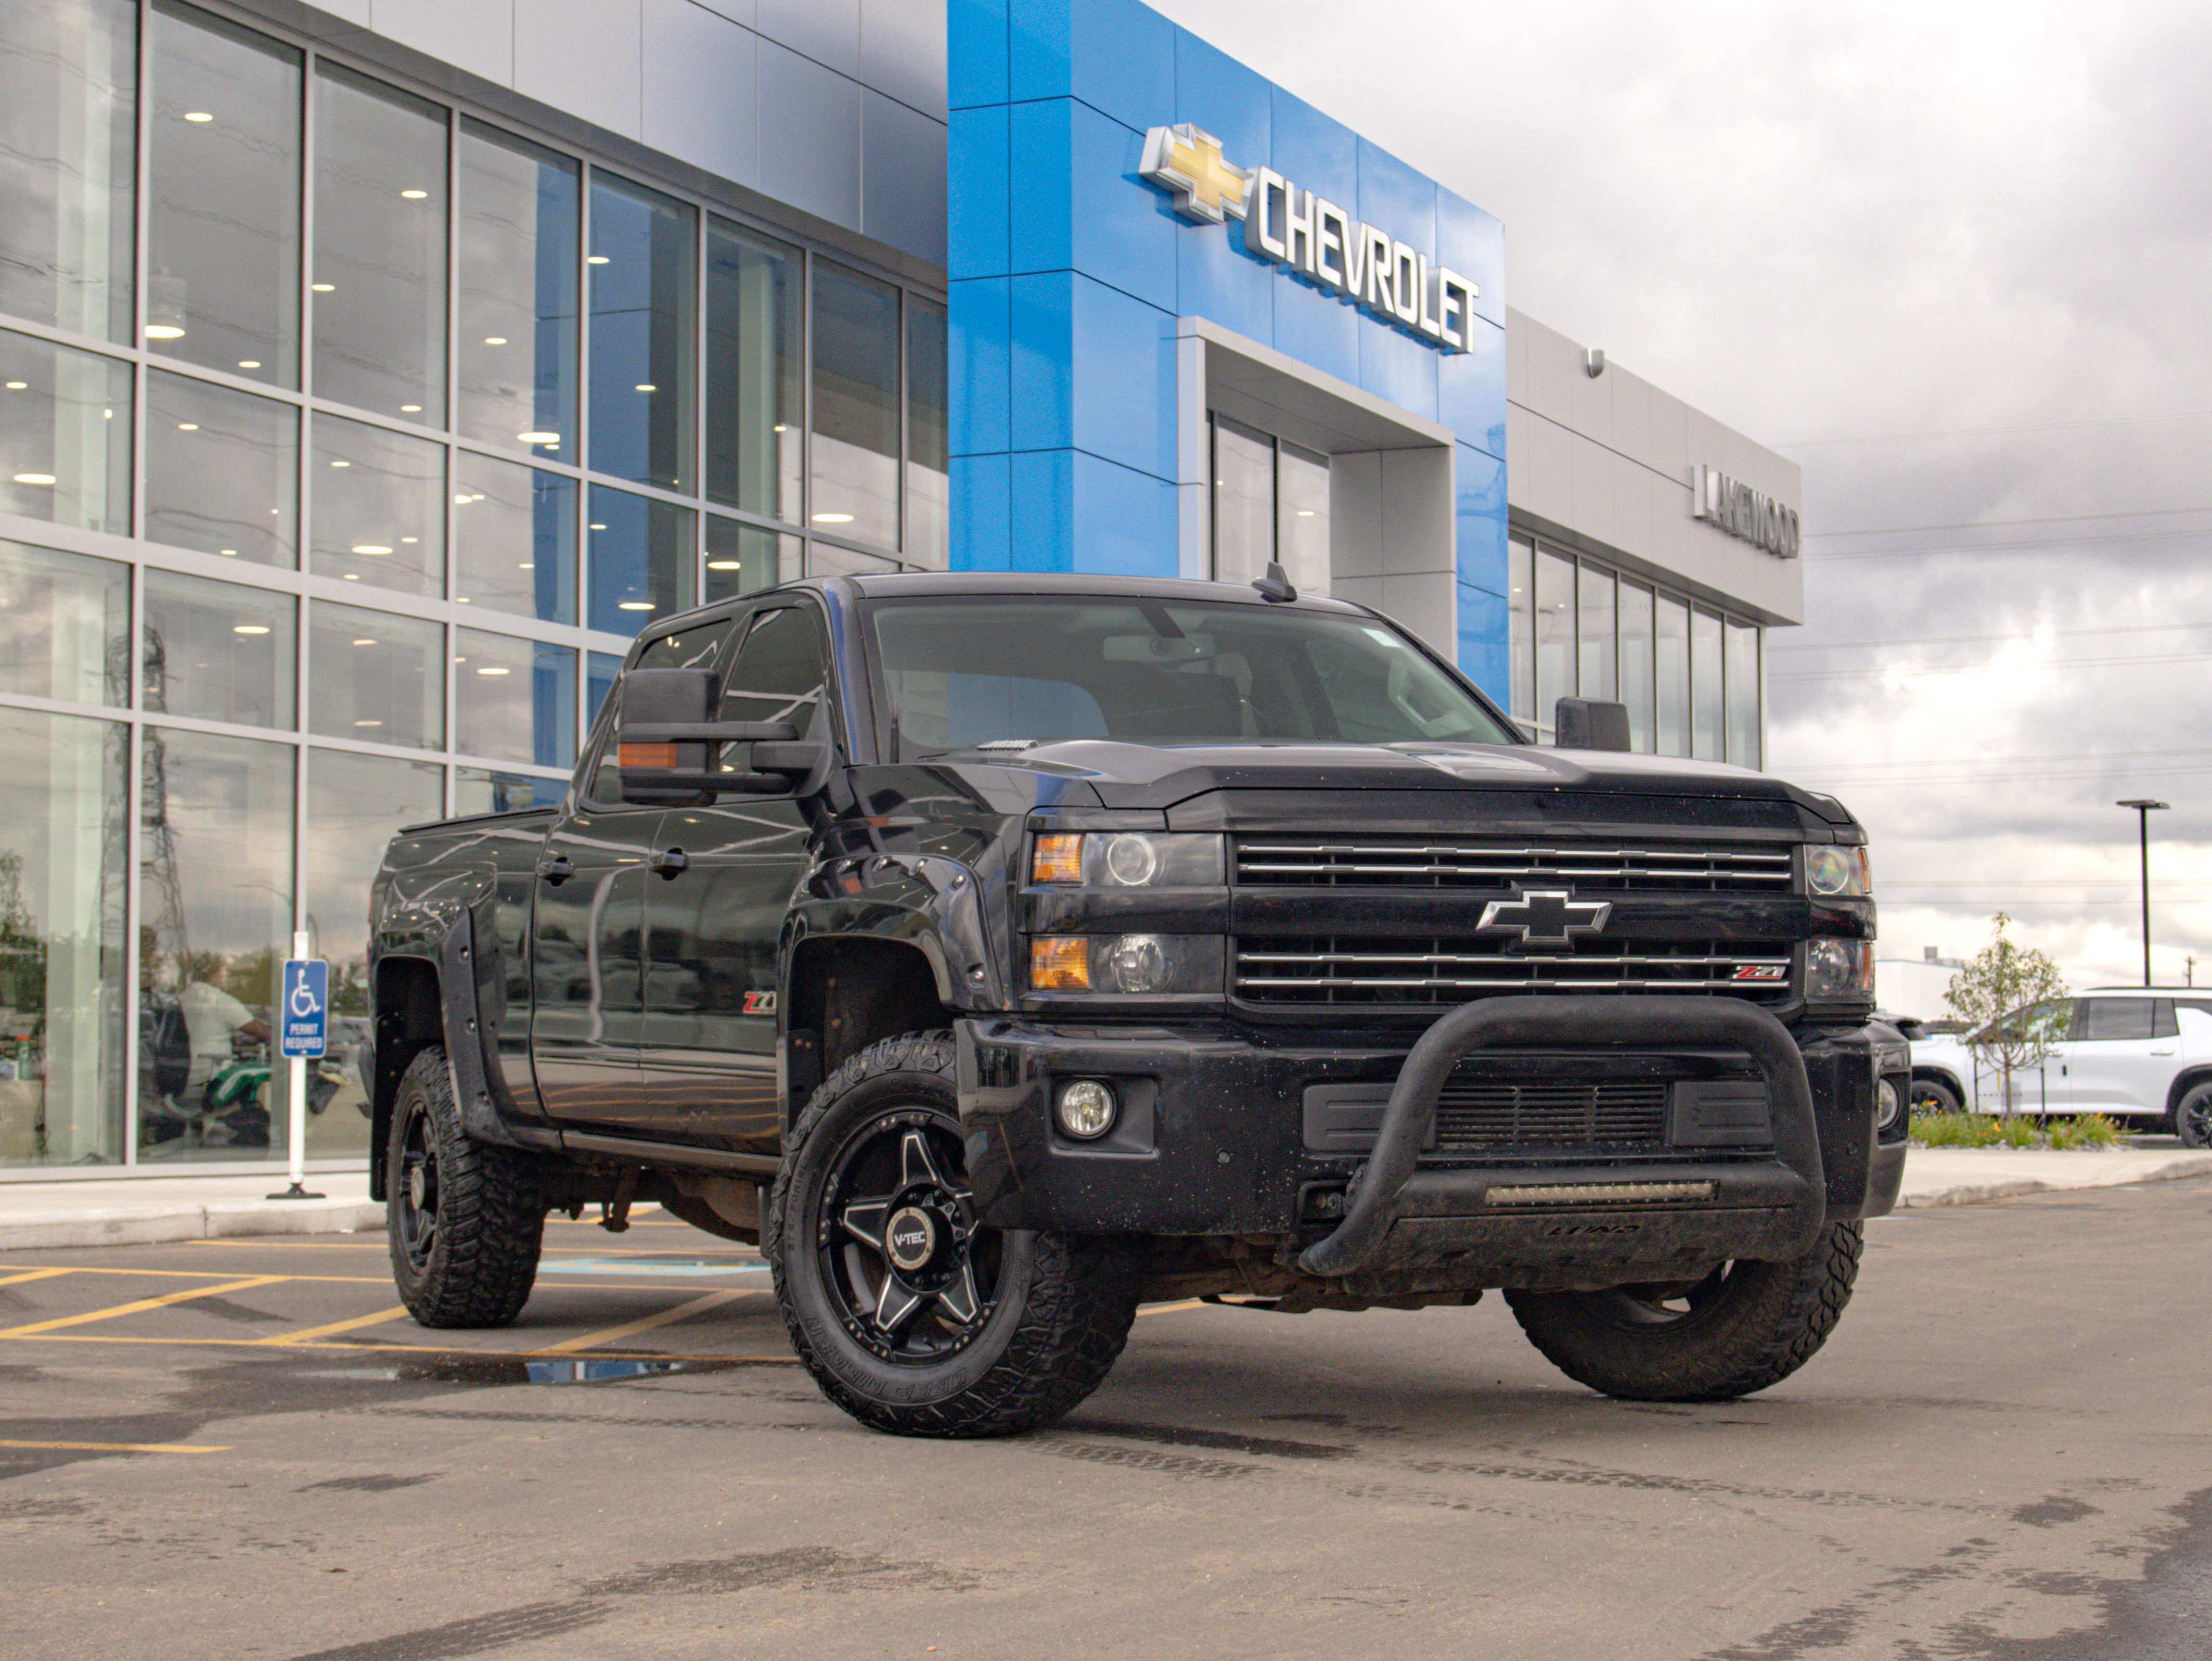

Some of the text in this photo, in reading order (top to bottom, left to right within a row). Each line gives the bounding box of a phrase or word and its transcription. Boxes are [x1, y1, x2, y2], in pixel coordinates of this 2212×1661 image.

[1254, 165, 1479, 354] CHEVROLET
[1693, 464, 1799, 559] LAKEWOOD
[289, 1023, 319, 1036] PERMIT
[285, 1037, 323, 1050] REQUIRED
[894, 1231, 926, 1247] V-TEC
